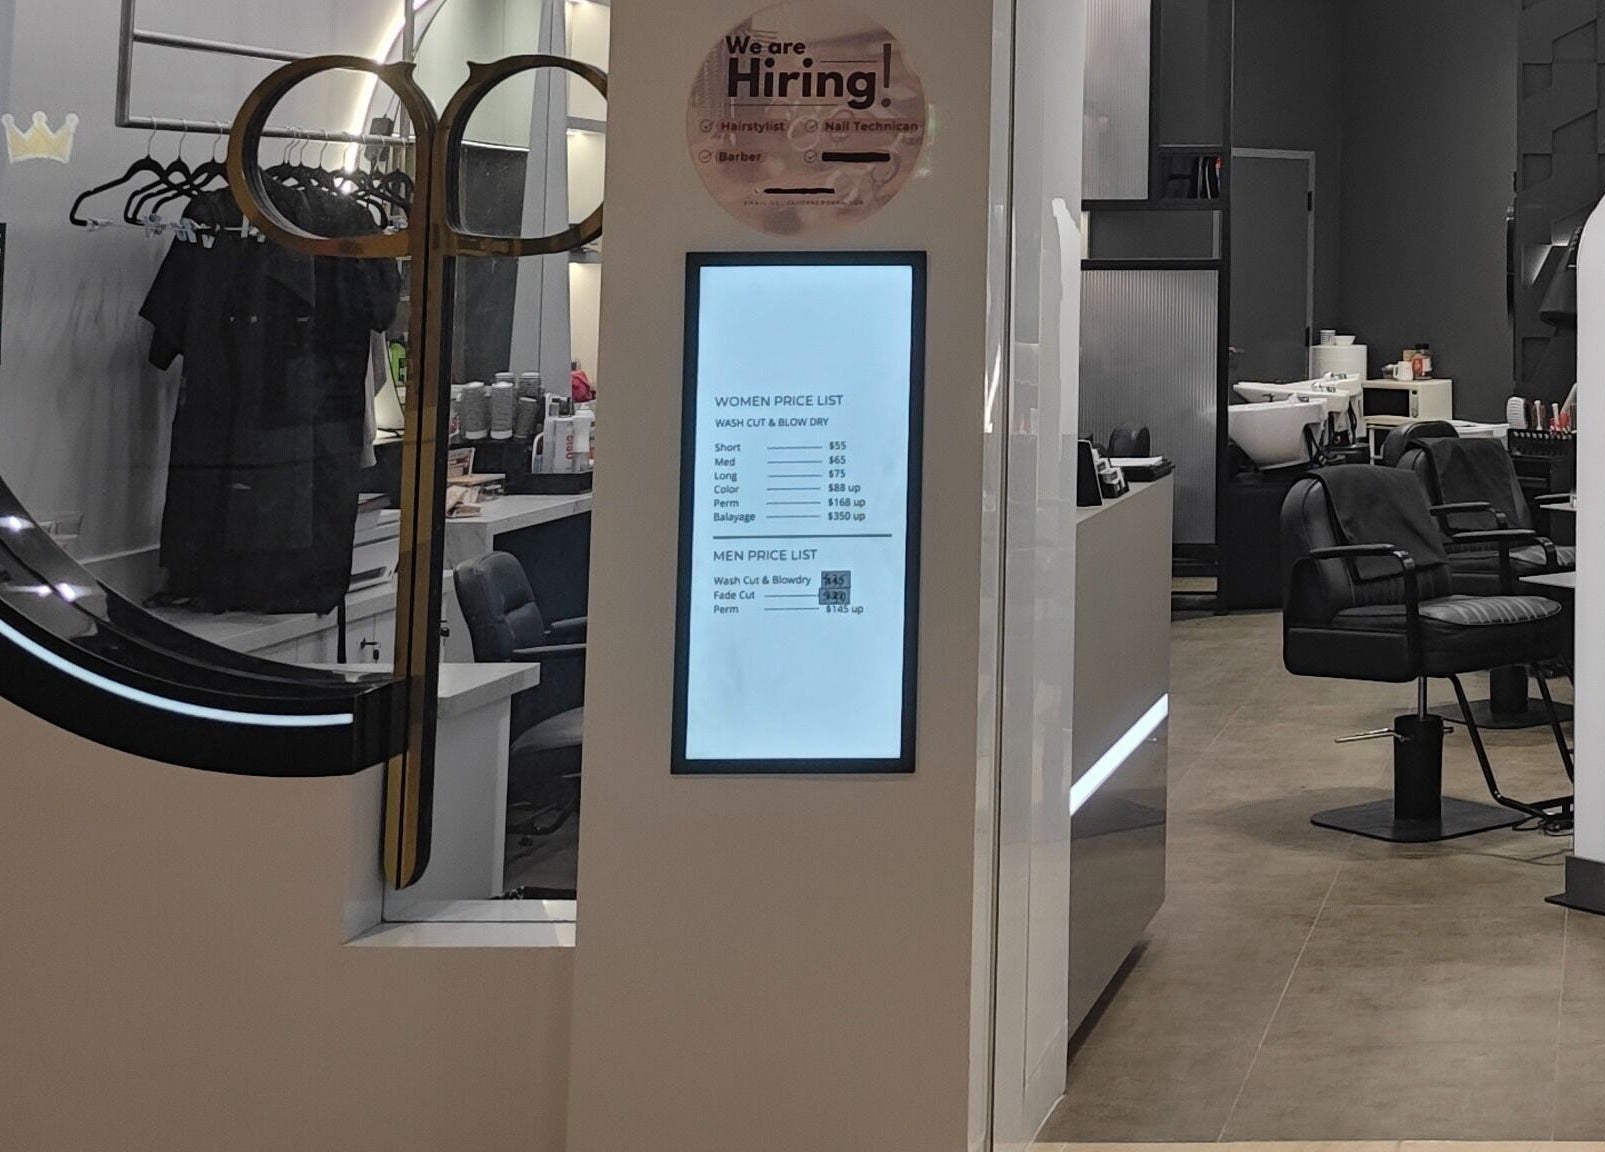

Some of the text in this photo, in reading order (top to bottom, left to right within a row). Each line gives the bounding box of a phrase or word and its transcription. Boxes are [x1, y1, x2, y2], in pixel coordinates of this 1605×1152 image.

[726, 36, 806, 55] We are
[728, 43, 892, 109] Hiring!
[721, 121, 785, 133] Hairstylist
[825, 121, 850, 132] Nail
[719, 152, 761, 162] Barber
[715, 395, 843, 407] WOMEN PRICE LIST
[715, 417, 829, 427] WASH CUT & BLOW DRY
[715, 440, 846, 452] Short $55
[715, 455, 846, 466] Med $65
[714, 469, 846, 482] Long $75
[714, 485, 739, 494] Color
[848, 485, 861, 494] up
[714, 499, 739, 508] Perm
[853, 500, 866, 508] up
[713, 511, 866, 523] Balayage $350 up
[713, 549, 818, 561] MEN PRICE LIST
[713, 576, 740, 585] Wash
[743, 575, 760, 585] Cut
[762, 576, 769, 584] &
[772, 575, 812, 586] Blowdry
[714, 590, 737, 600] Fade
[739, 590, 755, 599] Cut
[713, 605, 739, 613] Perm
[851, 606, 864, 615] up
